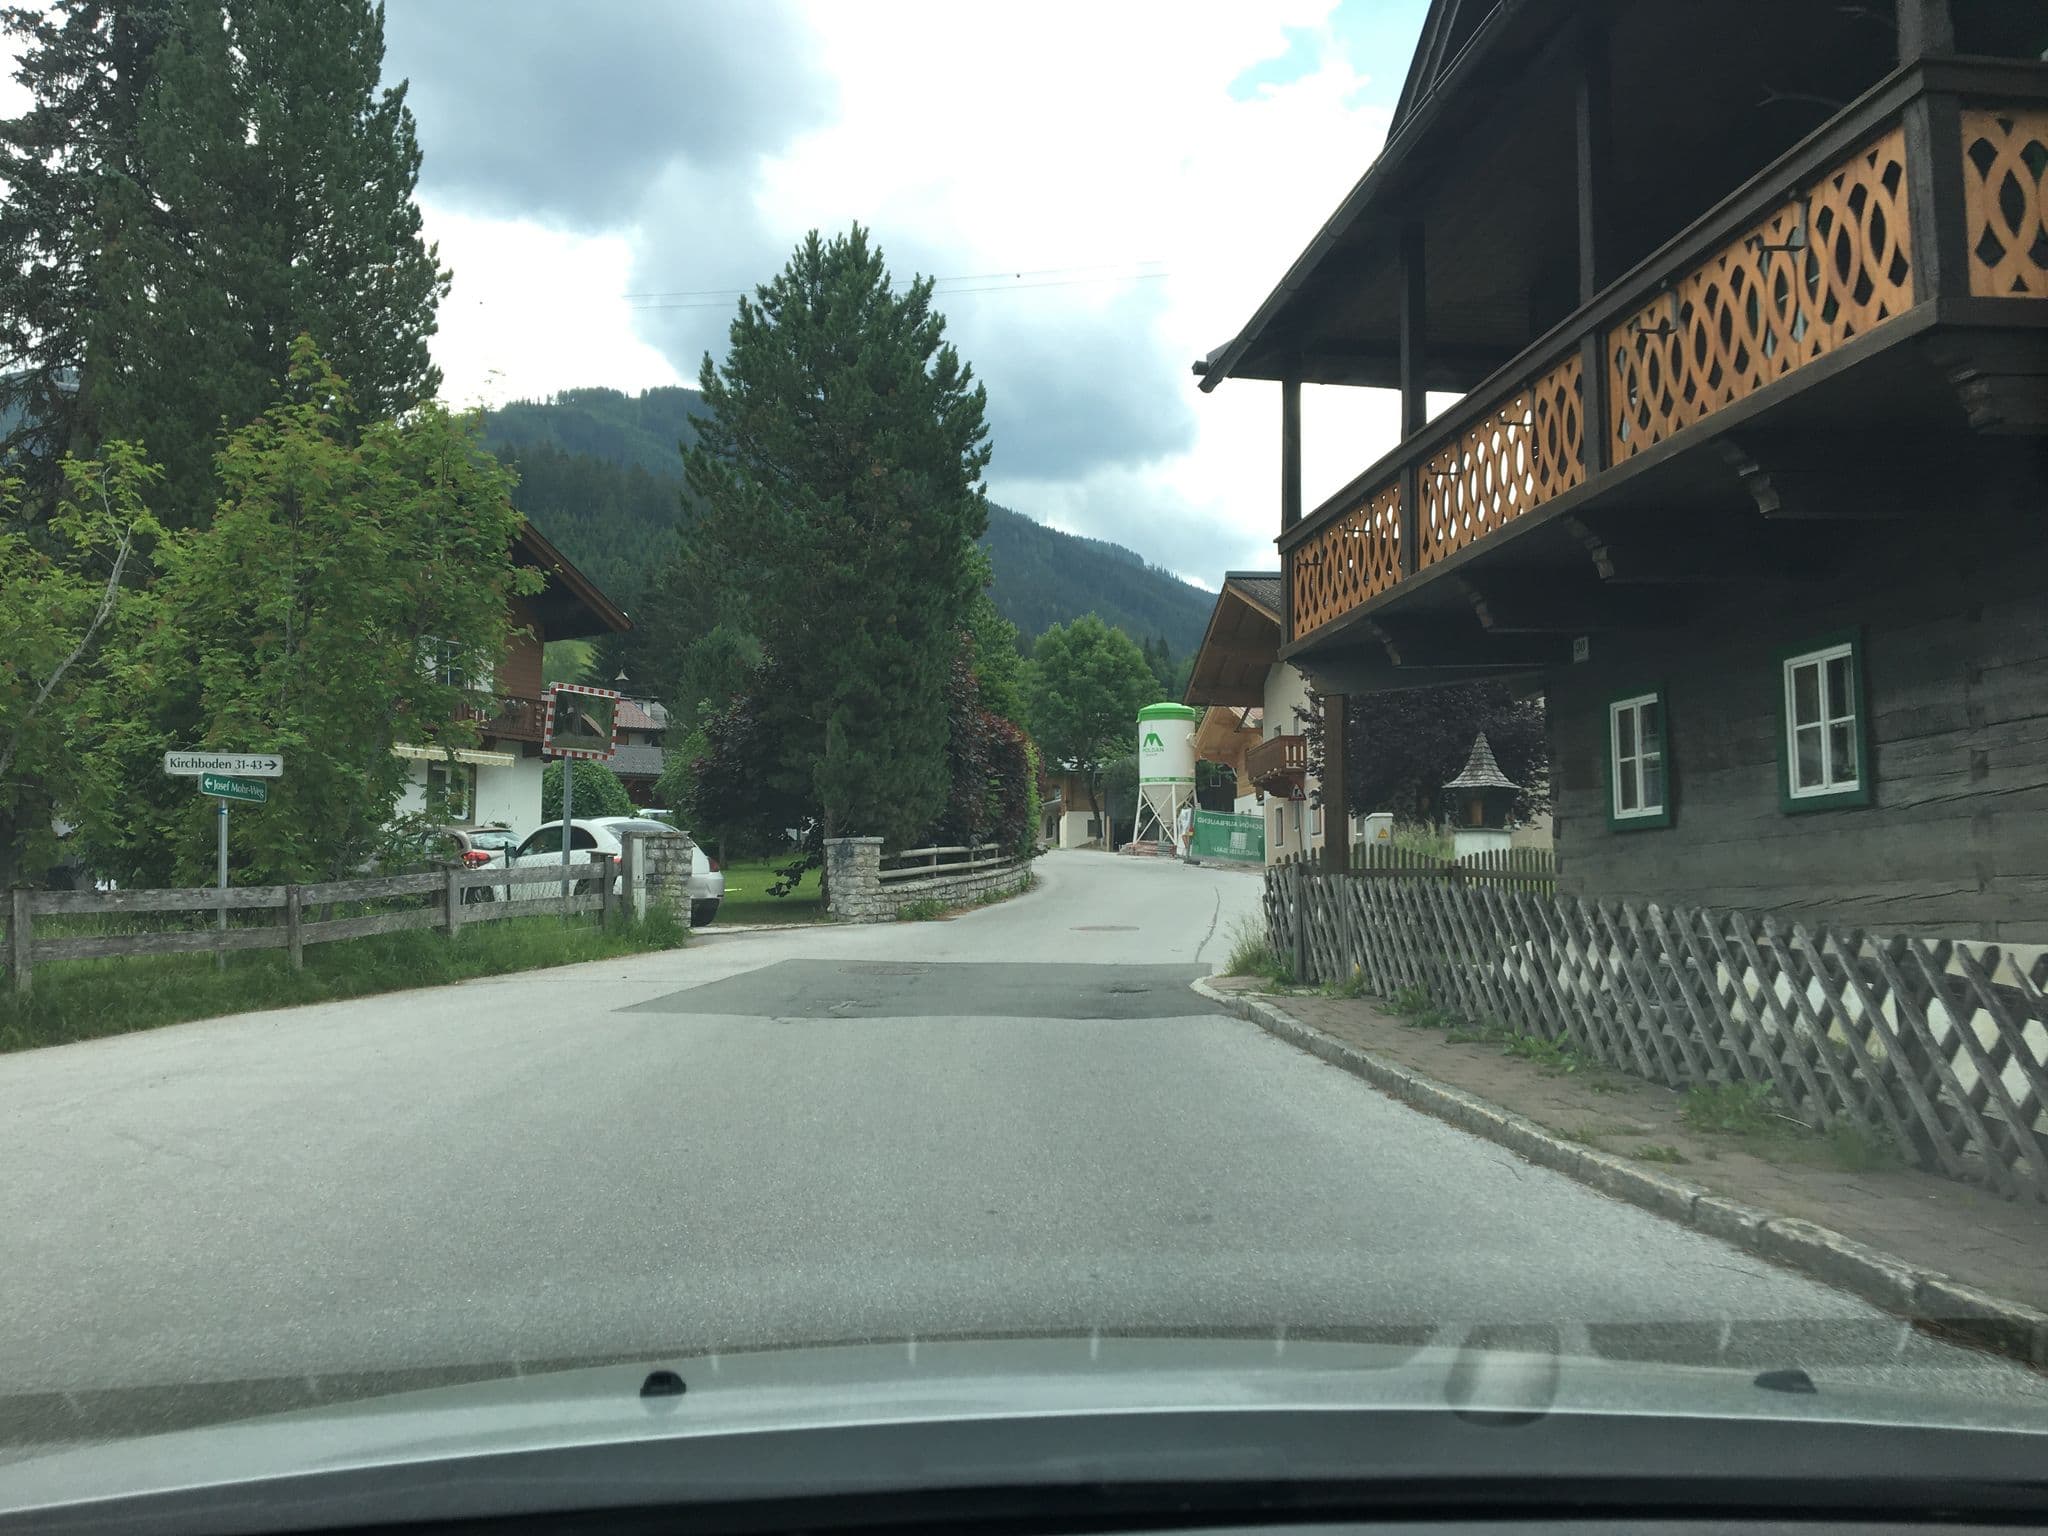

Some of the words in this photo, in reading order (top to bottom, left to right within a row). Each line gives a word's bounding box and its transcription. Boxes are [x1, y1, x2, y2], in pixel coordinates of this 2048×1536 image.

[170, 757, 231, 769] Kirchboden
[234, 759, 262, 770] 31-43
[213, 780, 230, 791] Josef
[231, 782, 264, 798] Mohr-Weg
